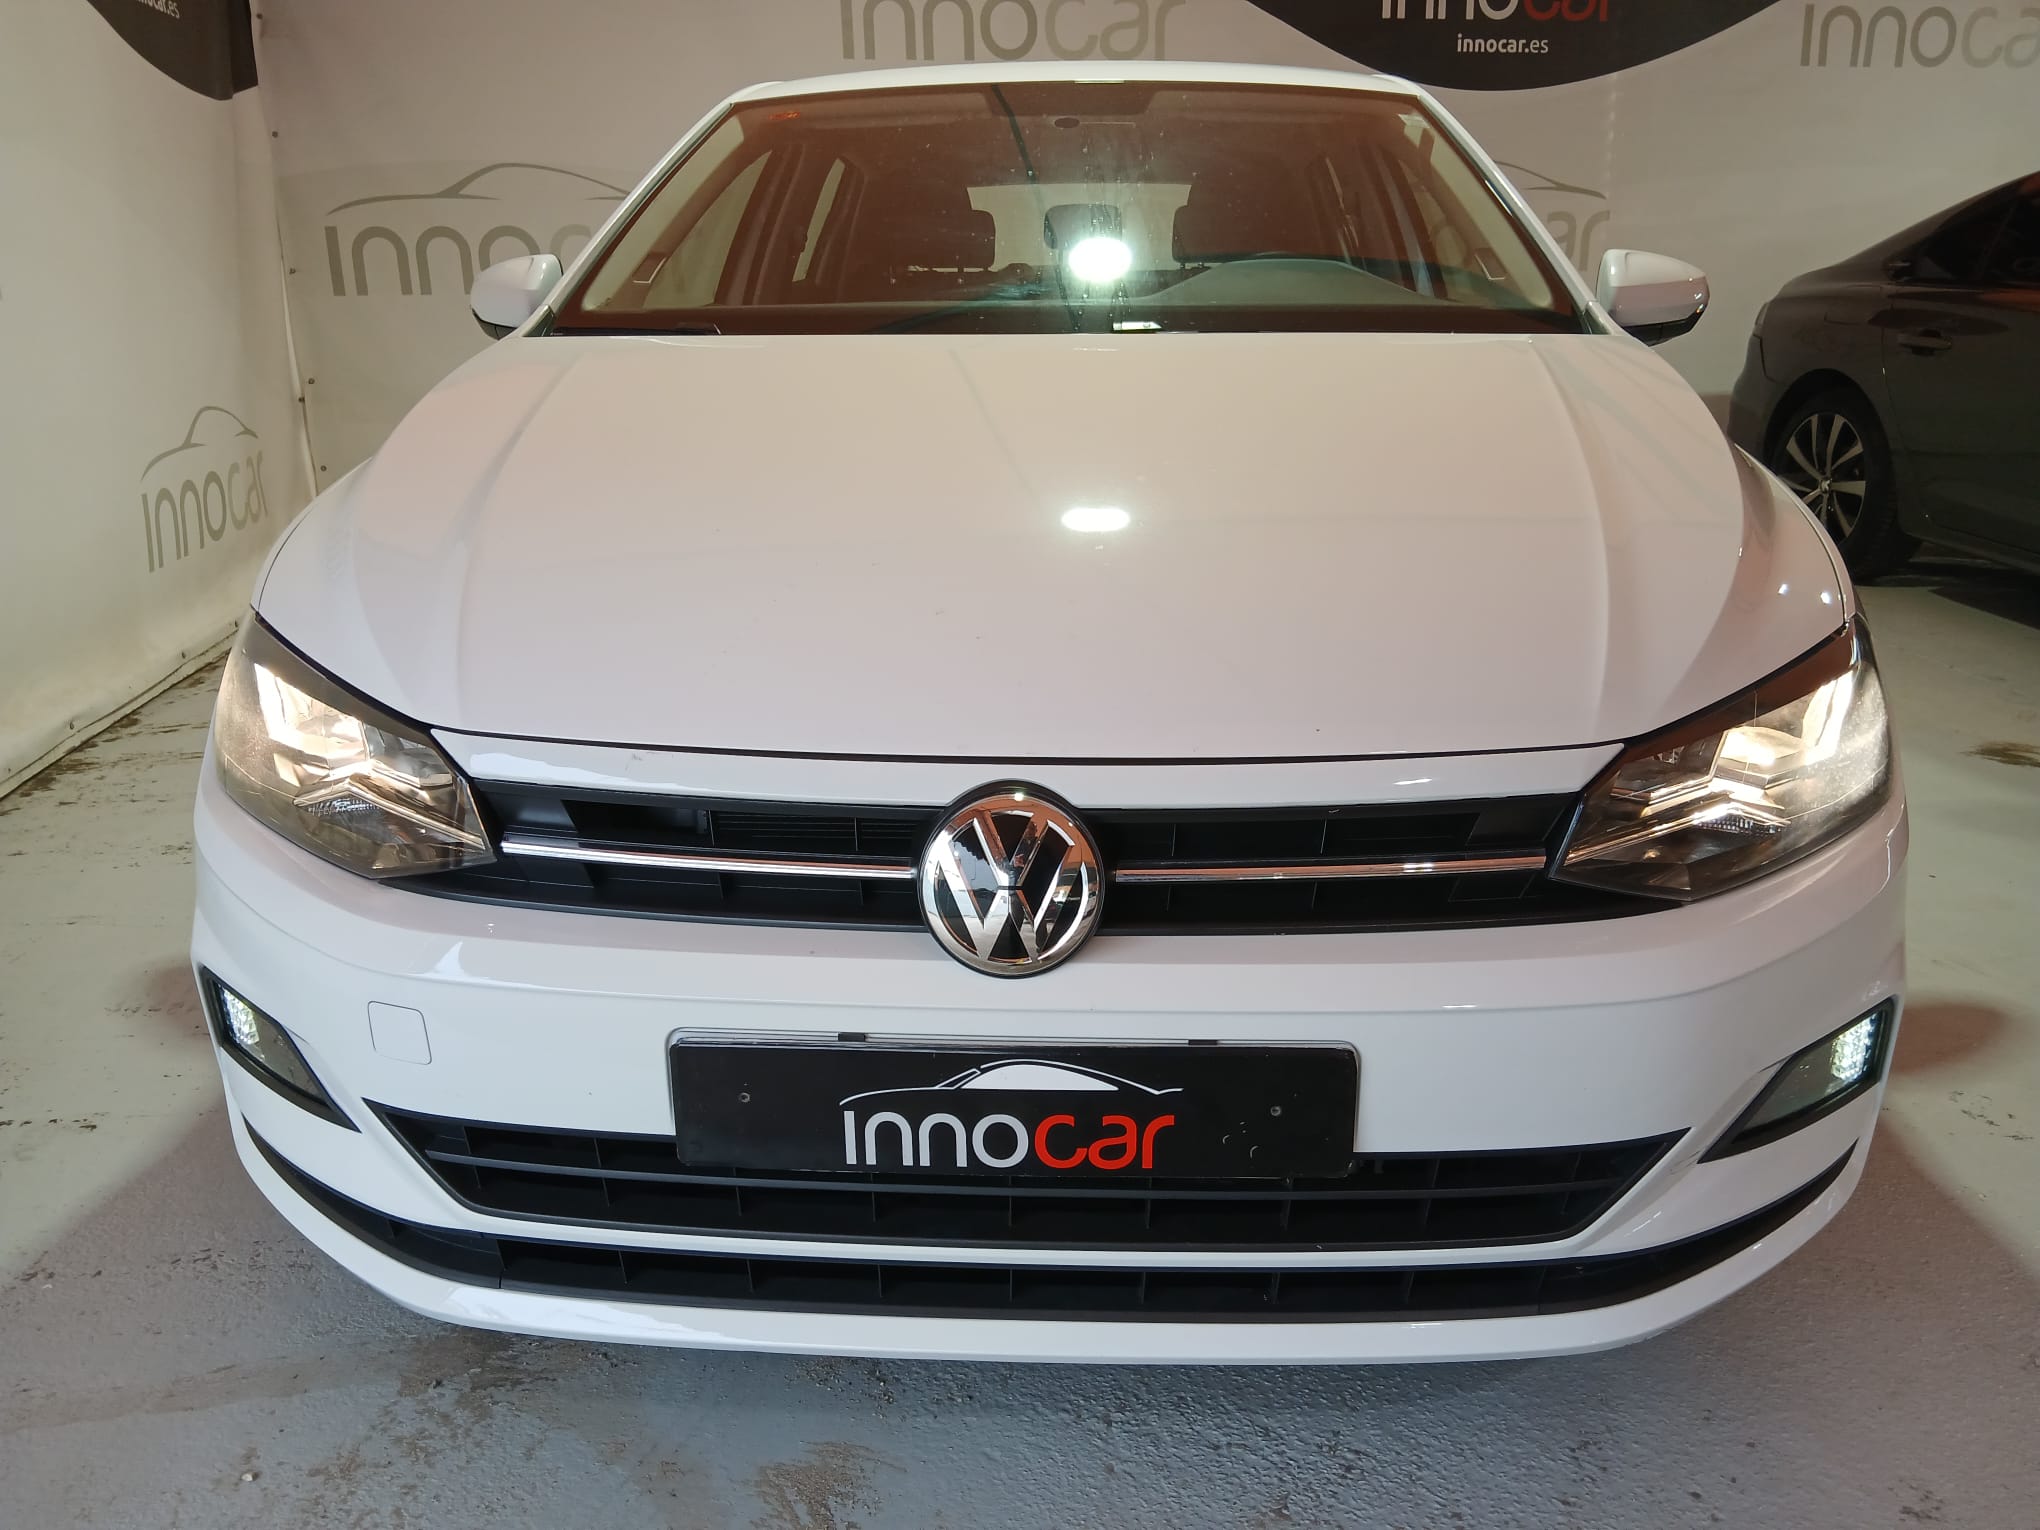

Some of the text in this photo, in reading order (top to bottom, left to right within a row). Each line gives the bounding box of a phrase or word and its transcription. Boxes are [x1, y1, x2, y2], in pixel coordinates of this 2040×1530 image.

[1457, 33, 1549, 53] innocar.es
[1799, 3, 2040, 68] innoca
[141, 450, 268, 573] innocar
[843, 1110, 1175, 1170] innocar
